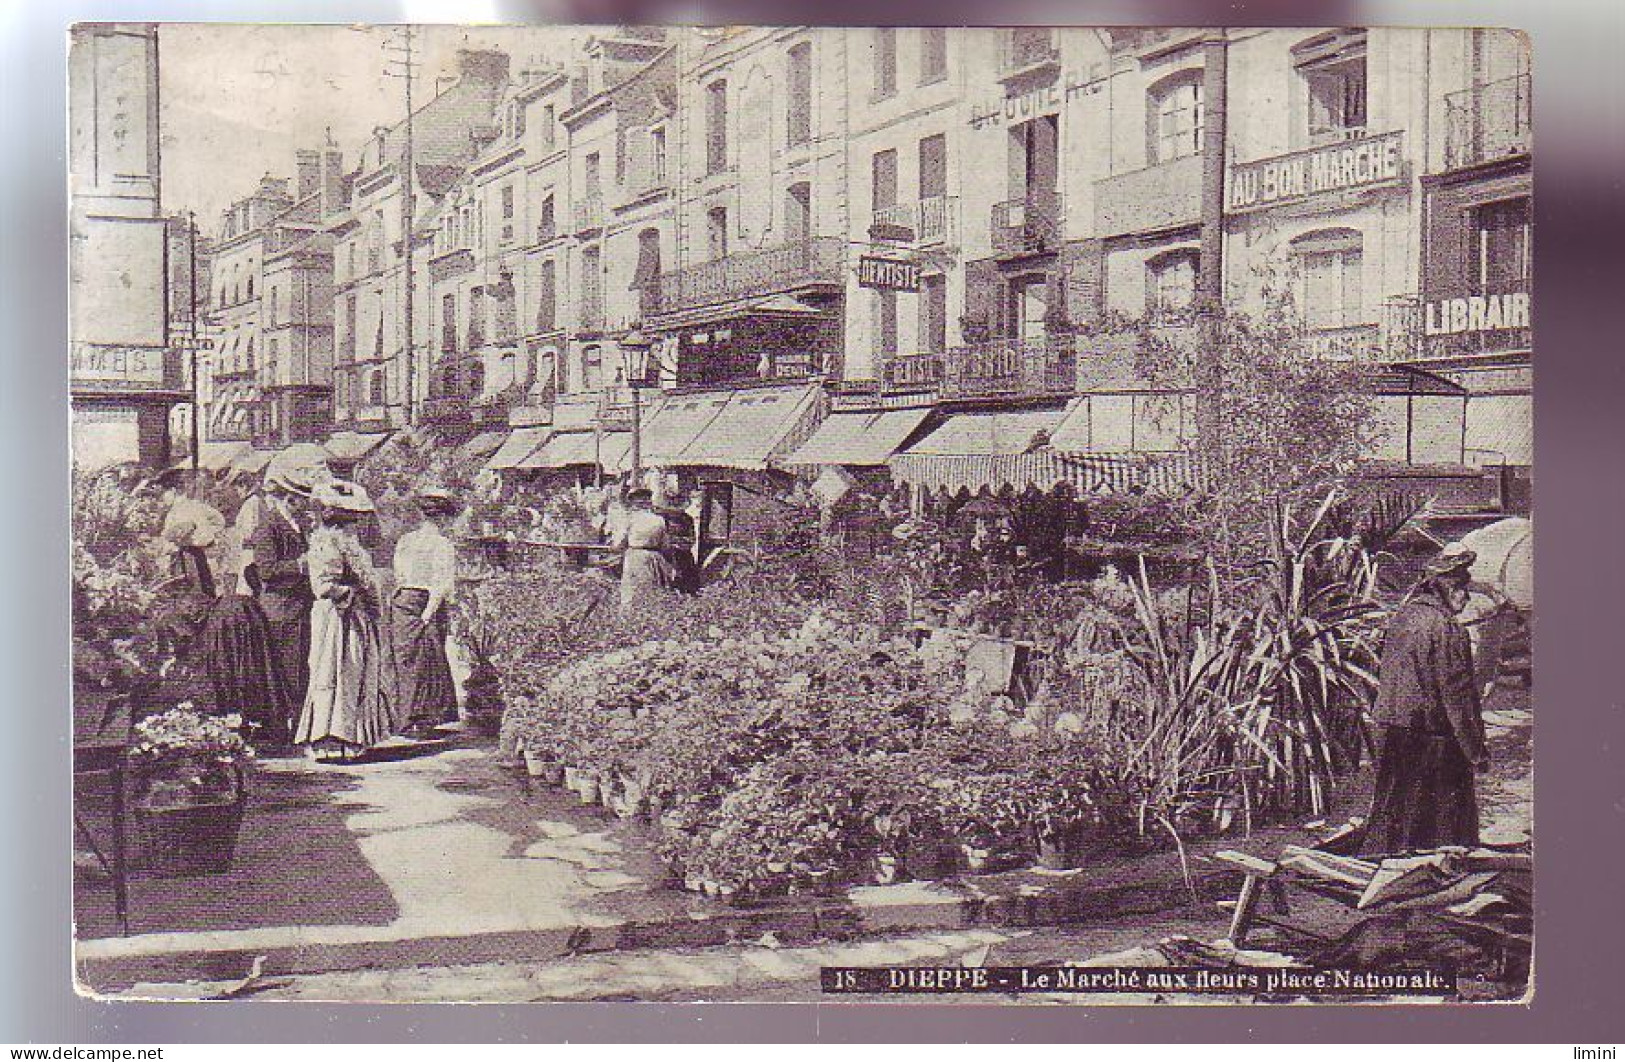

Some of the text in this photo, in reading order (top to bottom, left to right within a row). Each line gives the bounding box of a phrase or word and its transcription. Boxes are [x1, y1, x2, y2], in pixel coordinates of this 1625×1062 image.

[1233, 169, 1258, 207] AU
[1263, 159, 1305, 202] BON
[860, 258, 919, 289] DENTISTE
